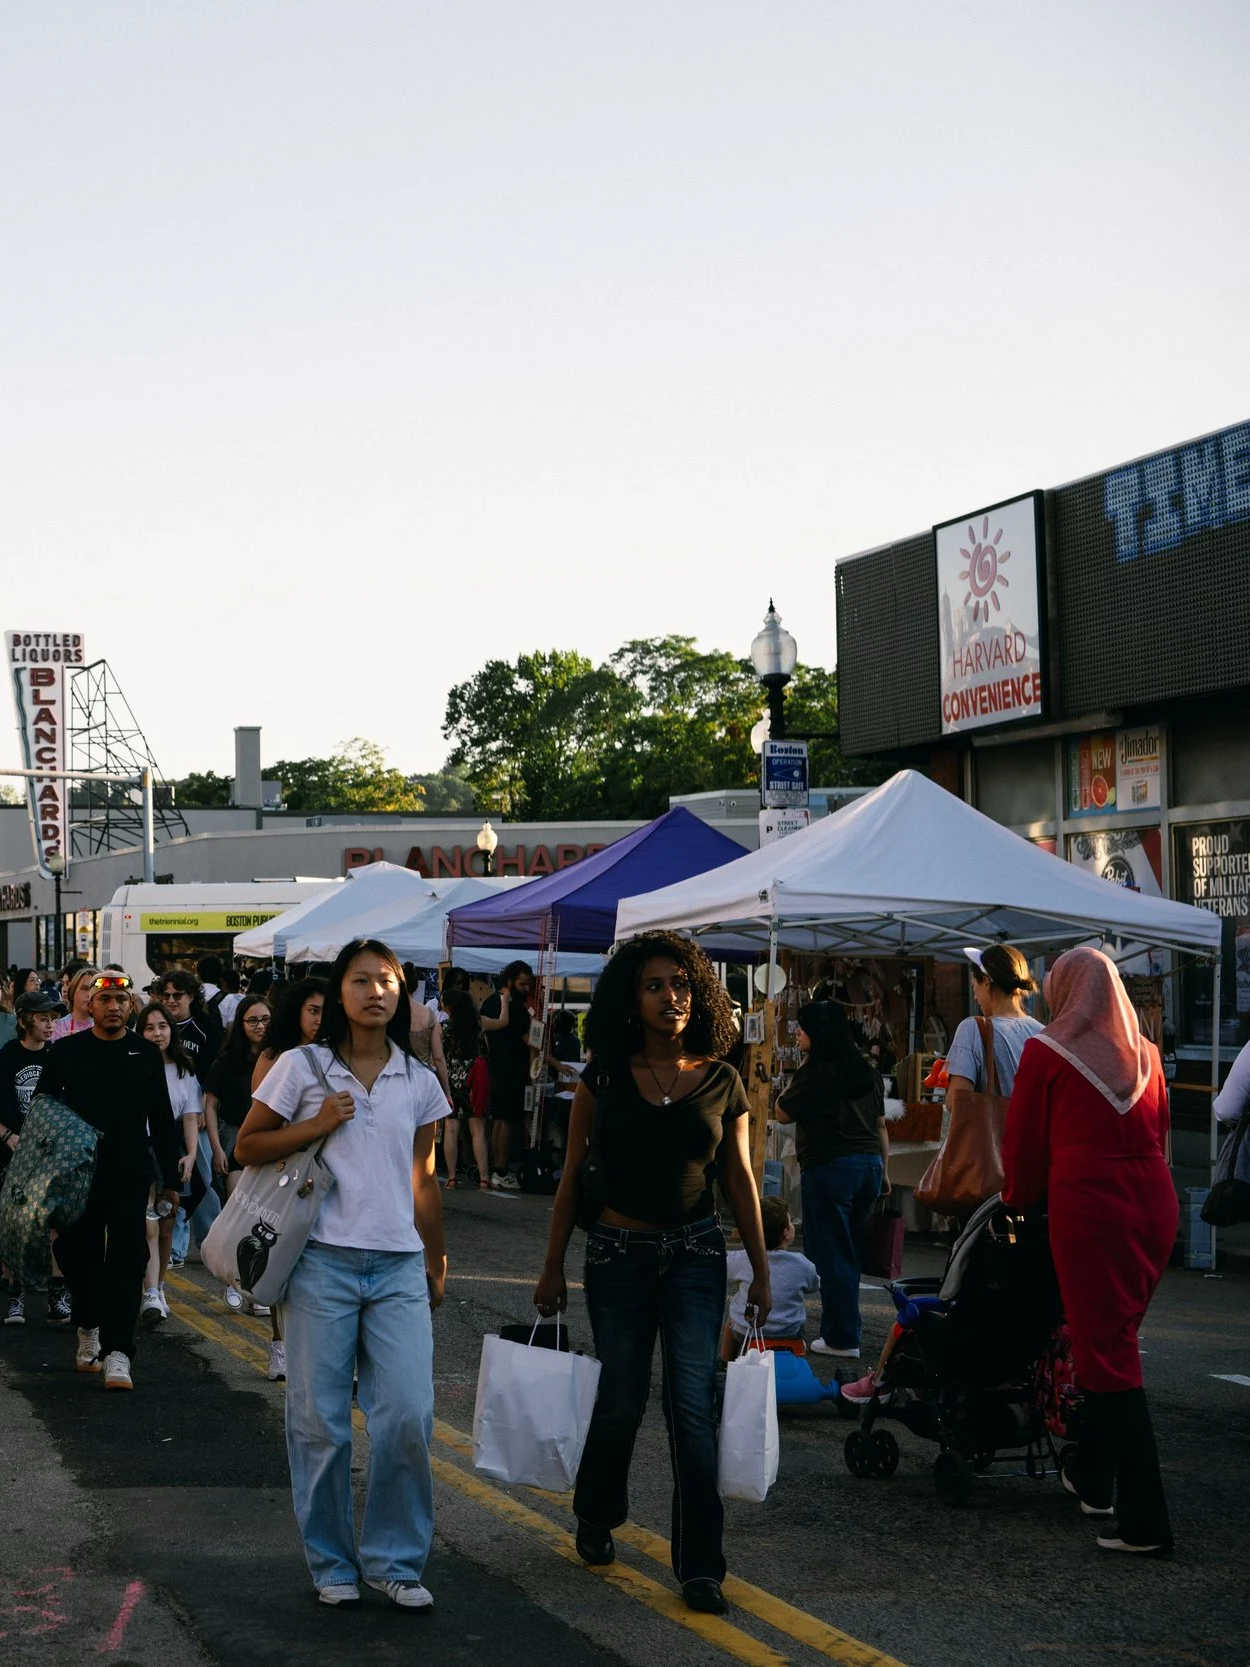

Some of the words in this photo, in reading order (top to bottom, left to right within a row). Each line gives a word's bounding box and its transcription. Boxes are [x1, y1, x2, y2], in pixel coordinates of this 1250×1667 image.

[12, 633, 81, 647] BOTTLED
[11, 648, 83, 663] LIQUORS
[952, 631, 1027, 679] HARVARD
[942, 672, 1042, 724] CONVENIENCE
[770, 744, 804, 754] Boston
[1121, 729, 1159, 765] Jimador
[771, 758, 802, 766] OPERATION
[1092, 747, 1111, 770] NEW
[769, 781, 790, 790] STREET
[791, 781, 804, 791] SAFE
[1192, 835, 1229, 857] PROUD
[1193, 853, 1250, 877] SUPPORTE
[1194, 878, 1207, 898] OF
[1210, 875, 1250, 897] MILITAR
[149, 917, 199, 927] thetriennial.org
[226, 915, 251, 927] BOSTON
